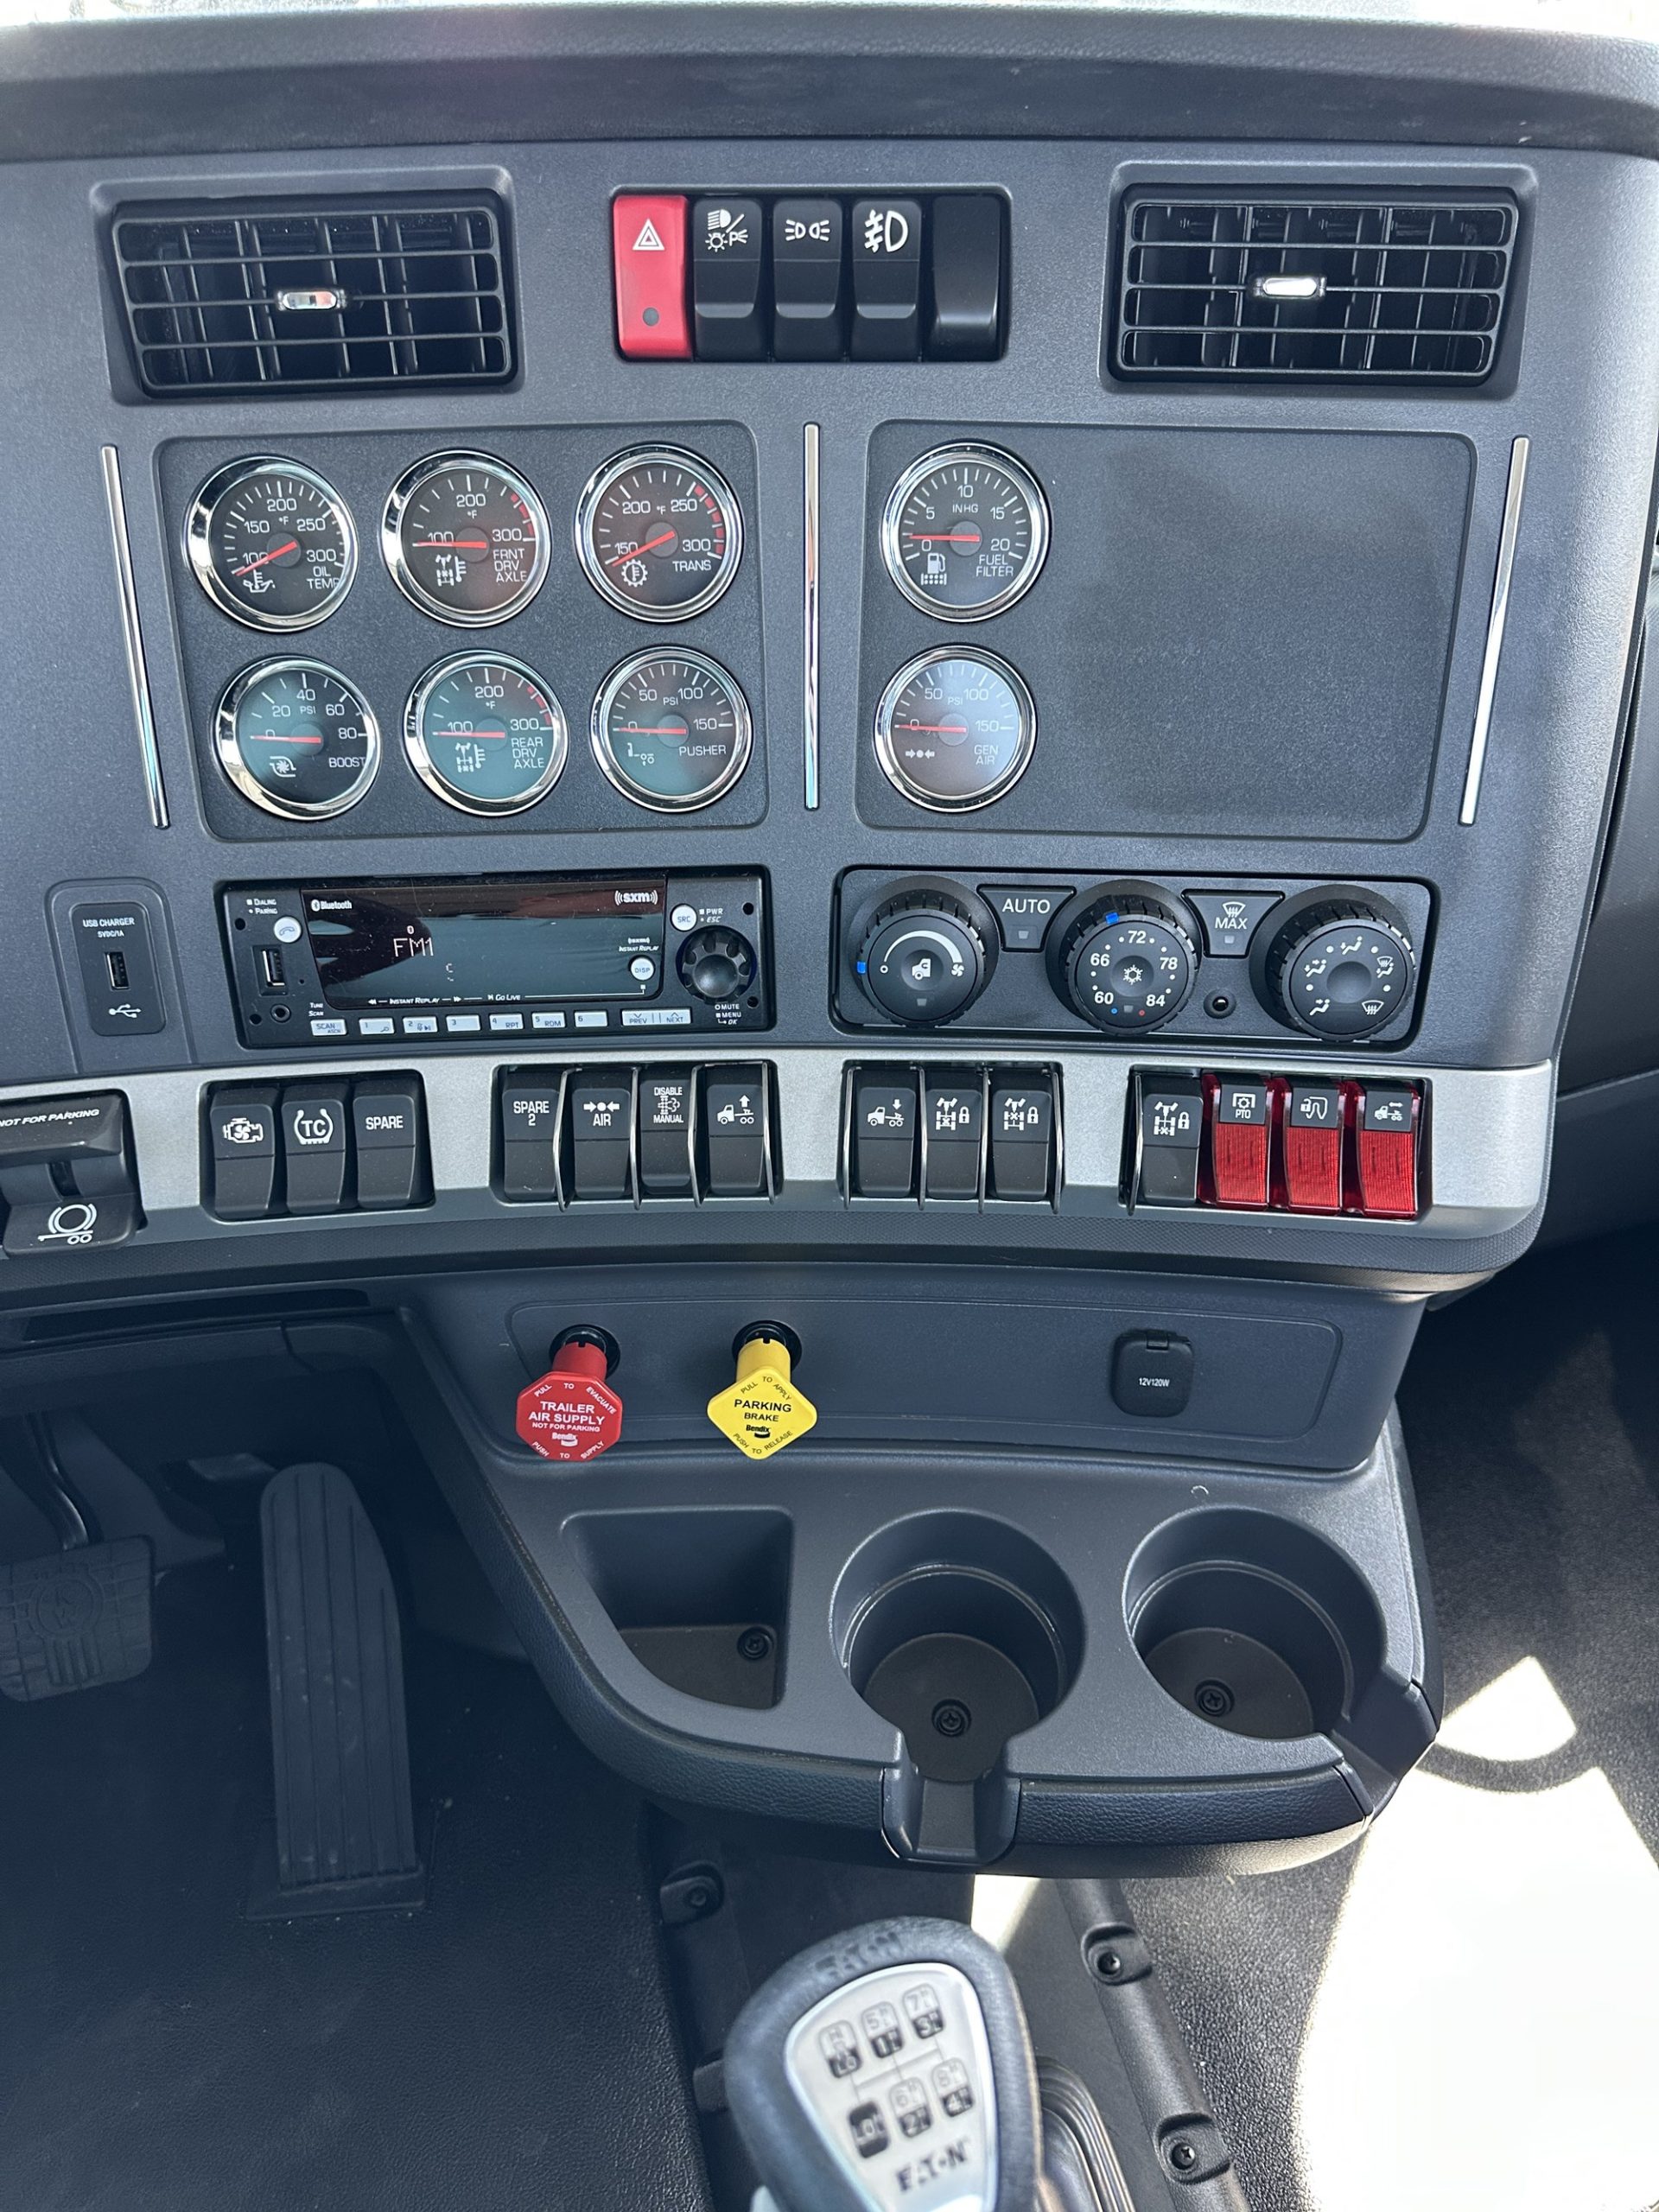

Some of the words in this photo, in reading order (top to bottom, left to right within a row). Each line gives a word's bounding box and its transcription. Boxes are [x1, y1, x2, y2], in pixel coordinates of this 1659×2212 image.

[957, 486, 973, 498] 10
[267, 499, 297, 512] 200
[456, 494, 486, 507] 200
[671, 499, 697, 512] 250
[623, 501, 651, 513] 200
[926, 507, 935, 519] 5
[990, 507, 1004, 519] 15
[245, 521, 270, 533] 150
[297, 519, 325, 531] 250
[428, 532, 454, 543] 100
[493, 529, 522, 542] 300
[615, 543, 638, 555] 150
[683, 539, 710, 552] 300
[922, 540, 931, 551] 0
[991, 538, 1010, 550] 20
[243, 553, 269, 565] 100
[307, 550, 336, 562] 300
[493, 549, 524, 559] FRNT
[979, 555, 1008, 565] FUEL
[494, 560, 519, 571] DRV
[673, 560, 711, 571] TRANS
[976, 567, 1013, 576] FILTER
[314, 567, 330, 577] OIL
[496, 572, 527, 582] AXLE
[307, 579, 340, 588] TEMP
[296, 690, 315, 701] 40
[475, 685, 504, 698] 200
[639, 690, 657, 701] 50
[678, 688, 702, 700] 100
[925, 689, 943, 700] 50
[963, 689, 988, 701] 100
[272, 705, 290, 716] 20
[326, 704, 344, 715] 60
[448, 721, 473, 733] 100
[511, 718, 538, 730] 300
[694, 718, 717, 730] 150
[975, 721, 999, 732] 150
[339, 728, 357, 739] 80
[512, 737, 543, 747] REAR
[512, 748, 537, 758] DRV
[679, 745, 727, 756] PUSHER
[975, 745, 998, 755] GEN
[329, 758, 365, 768] BOOST
[514, 758, 544, 768] AXLE
[976, 755, 995, 766] AIR
[623, 893, 650, 902] sxm
[321, 900, 352, 909] Bluetooth
[1002, 899, 1050, 913] AUTO
[99, 918, 135, 926] CHARGER
[1215, 918, 1248, 929] MAX
[1128, 931, 1146, 944] 72
[393, 938, 434, 957] FM1
[1090, 953, 1109, 966] 66
[1160, 957, 1178, 969] 78
[1095, 992, 1114, 1004] 60
[1147, 995, 1165, 1007] 84
[654, 1087, 683, 1096] DISABLE
[513, 1101, 549, 1114] SPARE
[22, 1116, 47, 1124] FOR
[48, 1109, 99, 1121] PARKING
[594, 1114, 611, 1126] AIR
[653, 1115, 683, 1123] MANUAL
[1236, 1109, 1251, 1119] PTO
[365, 1116, 403, 1129] SPARE
[529, 1115, 536, 1126] 2
[301, 1120, 326, 1136] TC
[741, 1382, 758, 1394] PULL
[773, 1383, 791, 1401] APPLY
[534, 1384, 552, 1397] PULL
[586, 1387, 617, 1414] EVACUATE
[540, 1401, 594, 1414] TRAILER
[734, 1399, 791, 1413] PARKING
[529, 1412, 550, 1421] AIR
[554, 1414, 605, 1425] SUPPLY
[744, 1413, 779, 1421] BRAKE
[734, 1433, 749, 1448] PUSH
[765, 1430, 793, 1451] RELEASE
[532, 1441, 550, 1457] PUSH
[581, 1440, 605, 1459] SUPPLY
[906, 1994, 918, 2011] 7
[866, 2012, 880, 2030] 5
[918, 2016, 931, 2035] 3
[947, 2094, 963, 2114] 4
